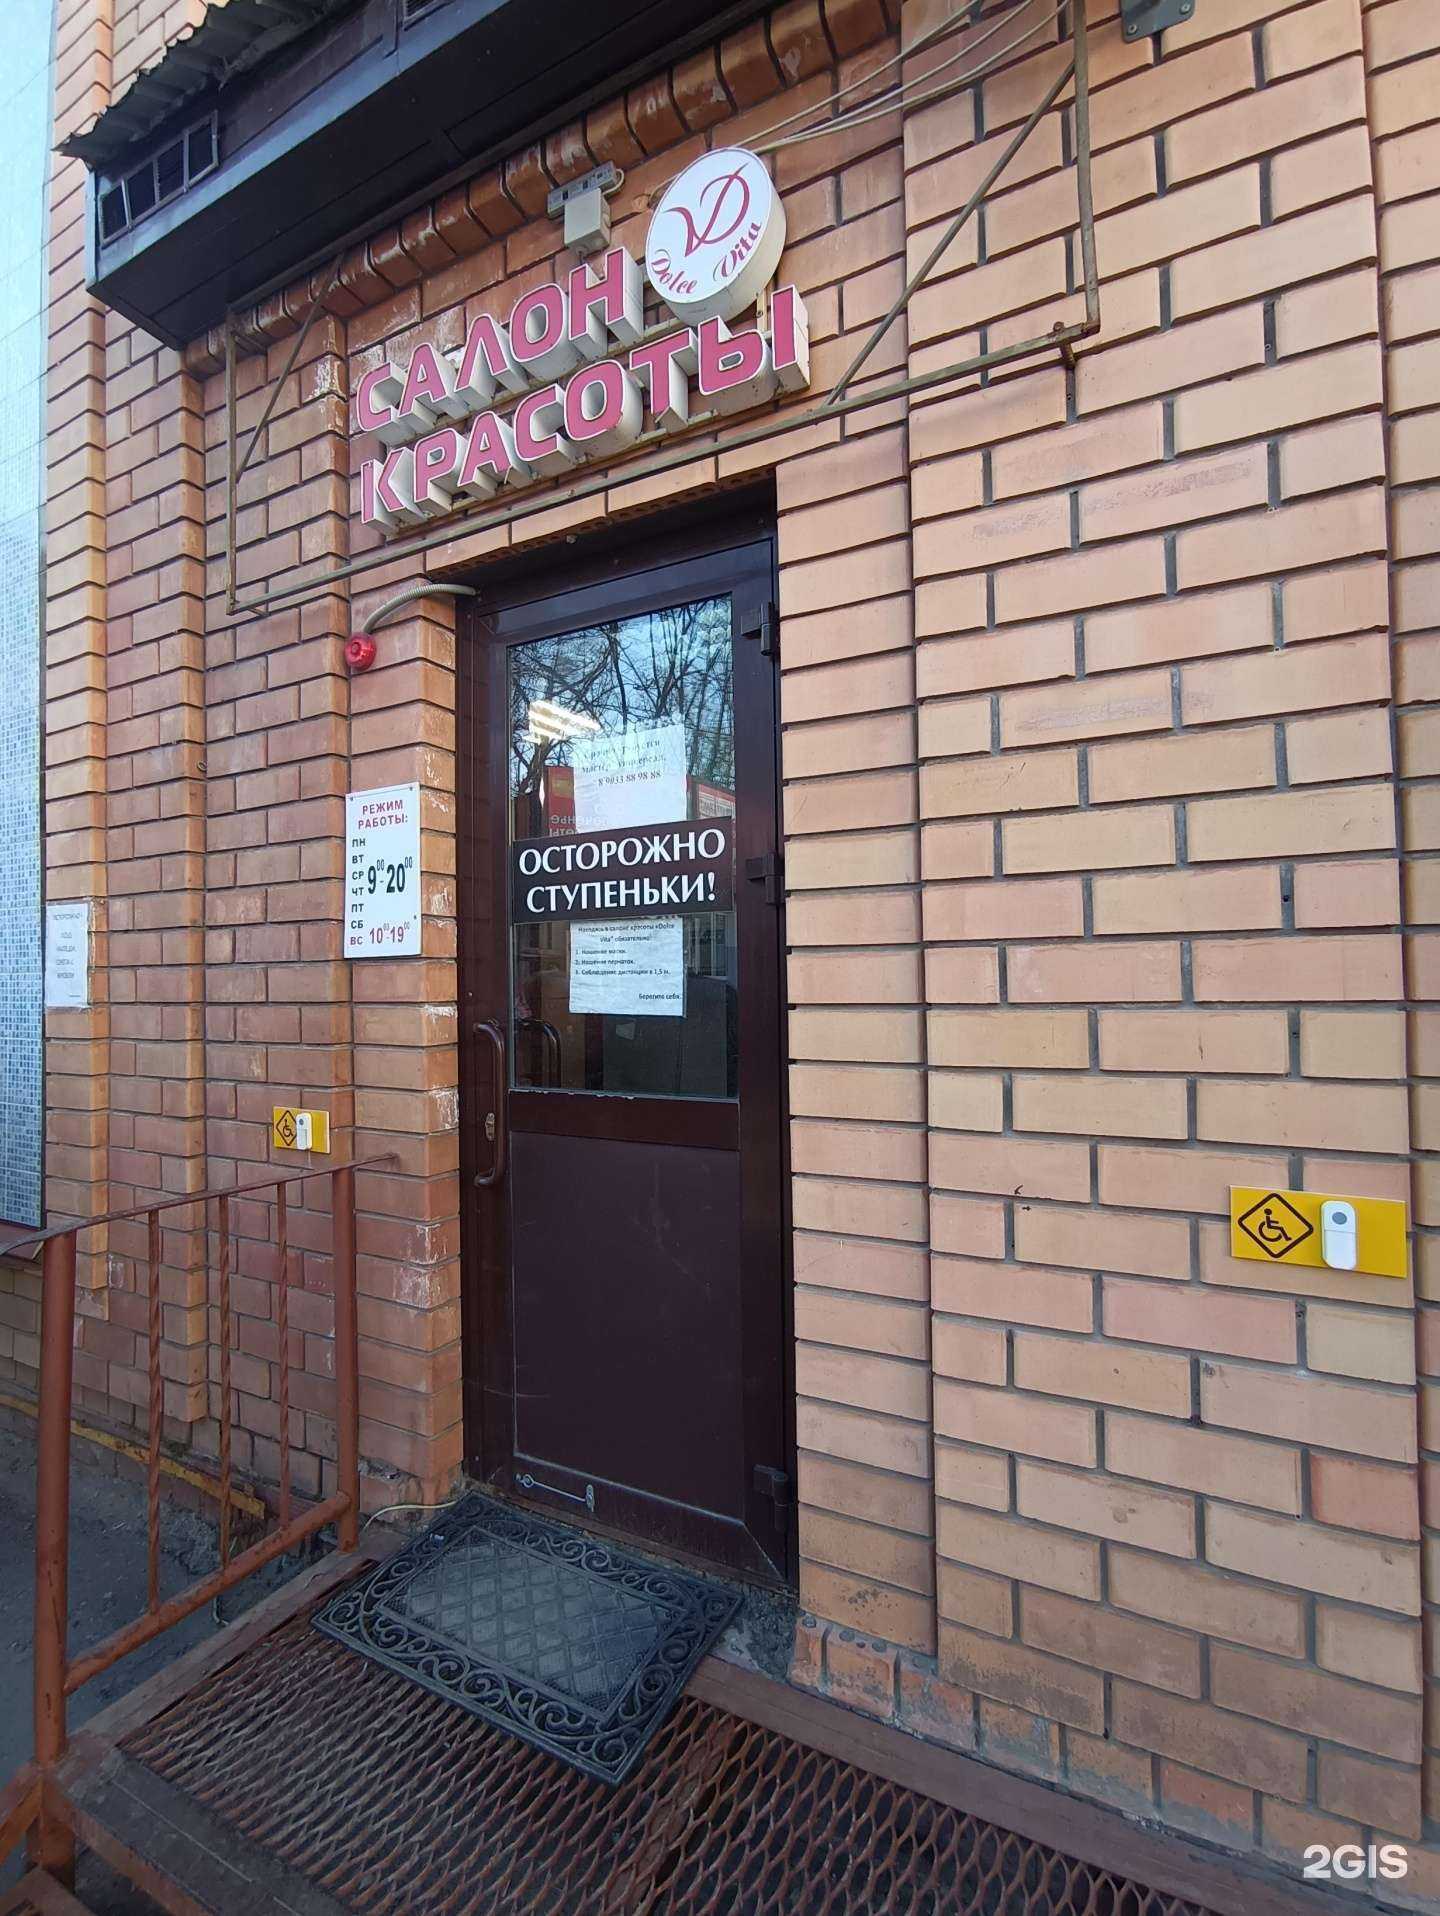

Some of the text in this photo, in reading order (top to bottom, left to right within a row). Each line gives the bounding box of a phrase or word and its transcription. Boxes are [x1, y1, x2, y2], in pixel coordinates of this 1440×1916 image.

[651, 222, 763, 294] Dolce Vita
[356, 246, 626, 432] САЛОН
[360, 285, 796, 524] КРАСОТЫ
[362, 800, 404, 816] РЕЖИМ
[358, 813, 409, 830] РАБОТЫ:
[351, 838, 366, 848] ПН
[518, 828, 726, 876] ОСТОРОЖНО
[352, 854, 365, 864] ВТ
[352, 871, 365, 880] СР
[352, 887, 365, 896] ЧТ
[526, 871, 716, 913] СТУПЕНЬКИ!
[351, 903, 365, 913] ПТ
[350, 920, 364, 929] СБ
[350, 936, 363, 946] ВС
